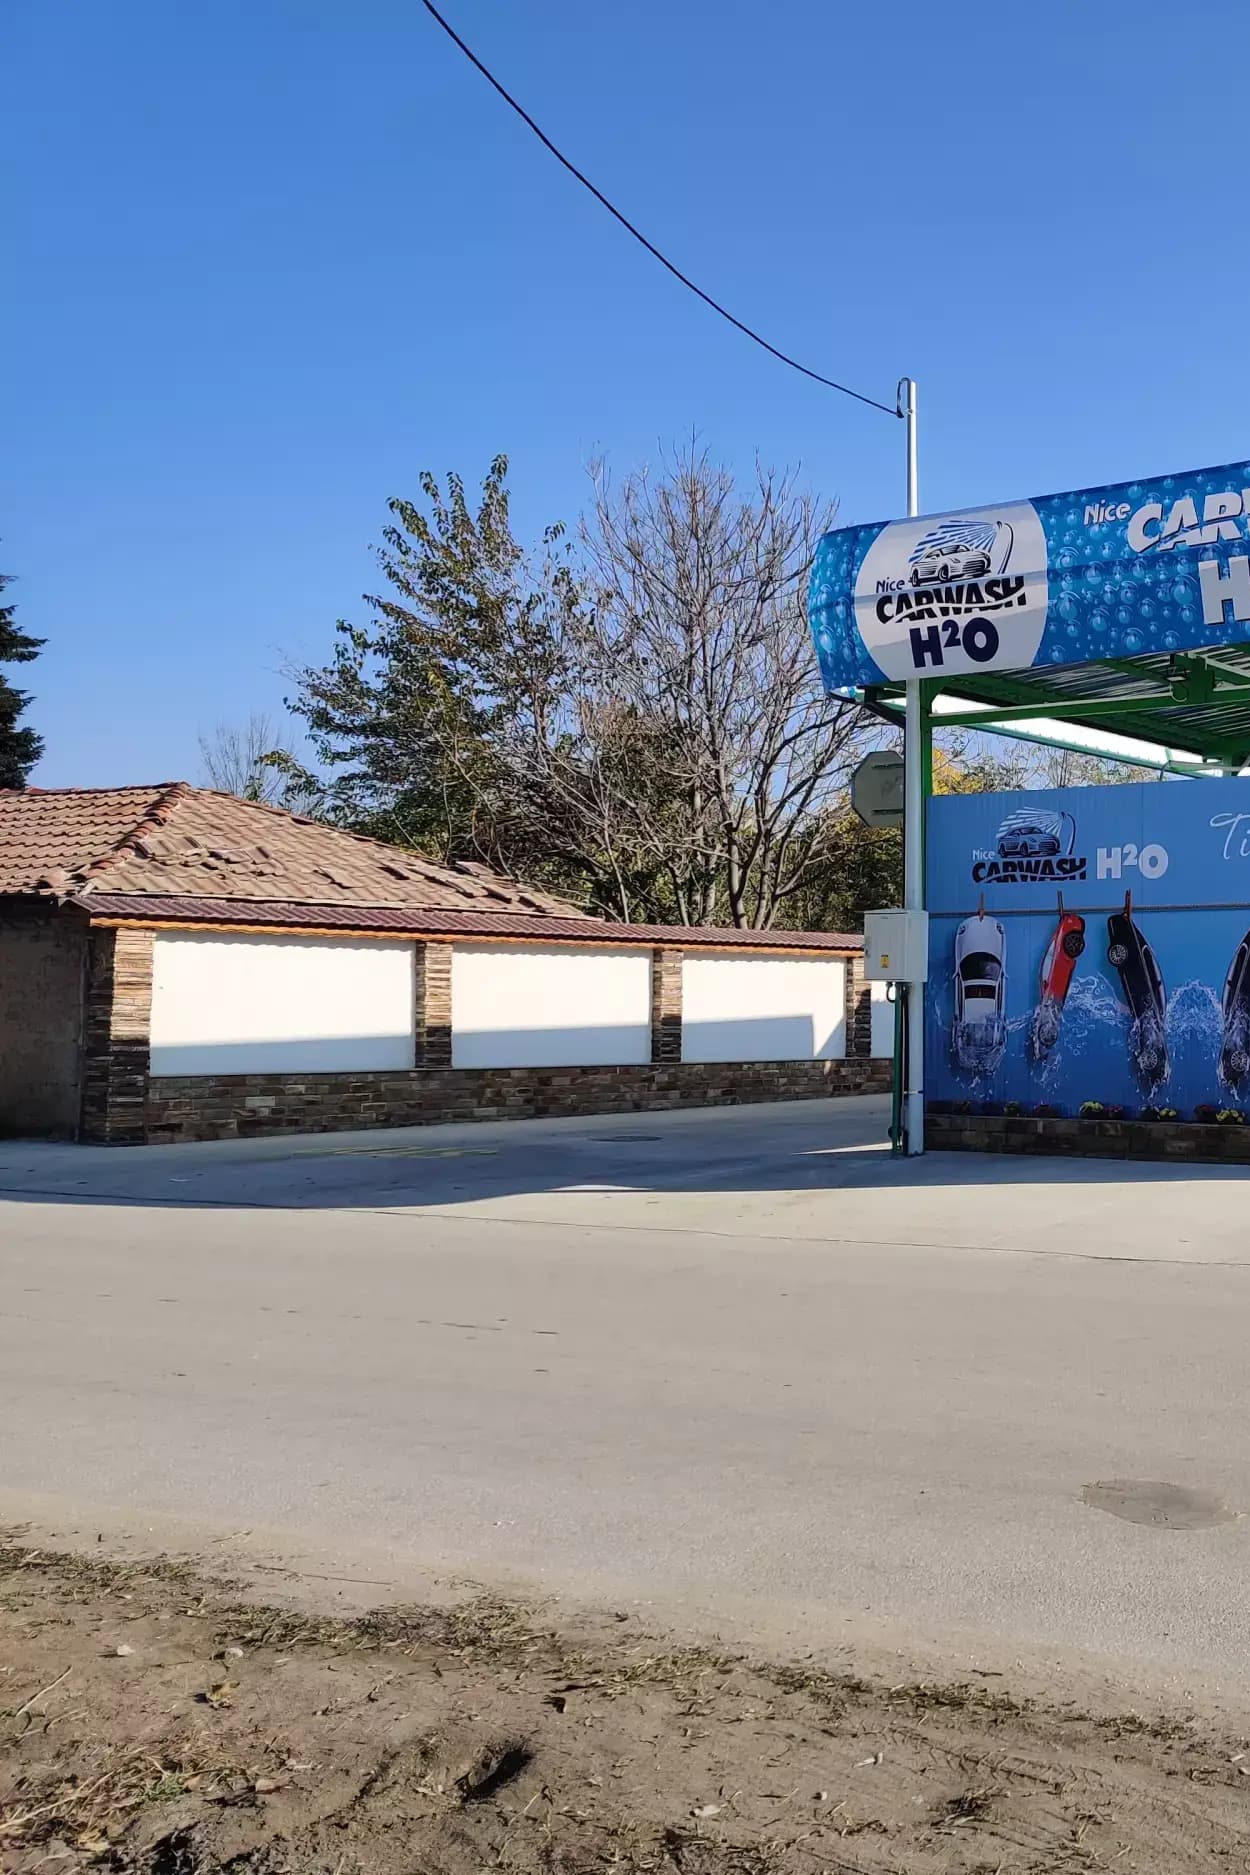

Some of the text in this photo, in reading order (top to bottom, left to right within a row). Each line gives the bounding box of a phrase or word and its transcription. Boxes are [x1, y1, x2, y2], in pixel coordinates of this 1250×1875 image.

[1084, 500, 1131, 527] Nice
[875, 577, 905, 594] Nice
[876, 576, 1027, 624] CARWASH
[909, 617, 999, 668] H2O
[972, 847, 996, 861] Nice
[972, 843, 1169, 884] CARWASH H2O
